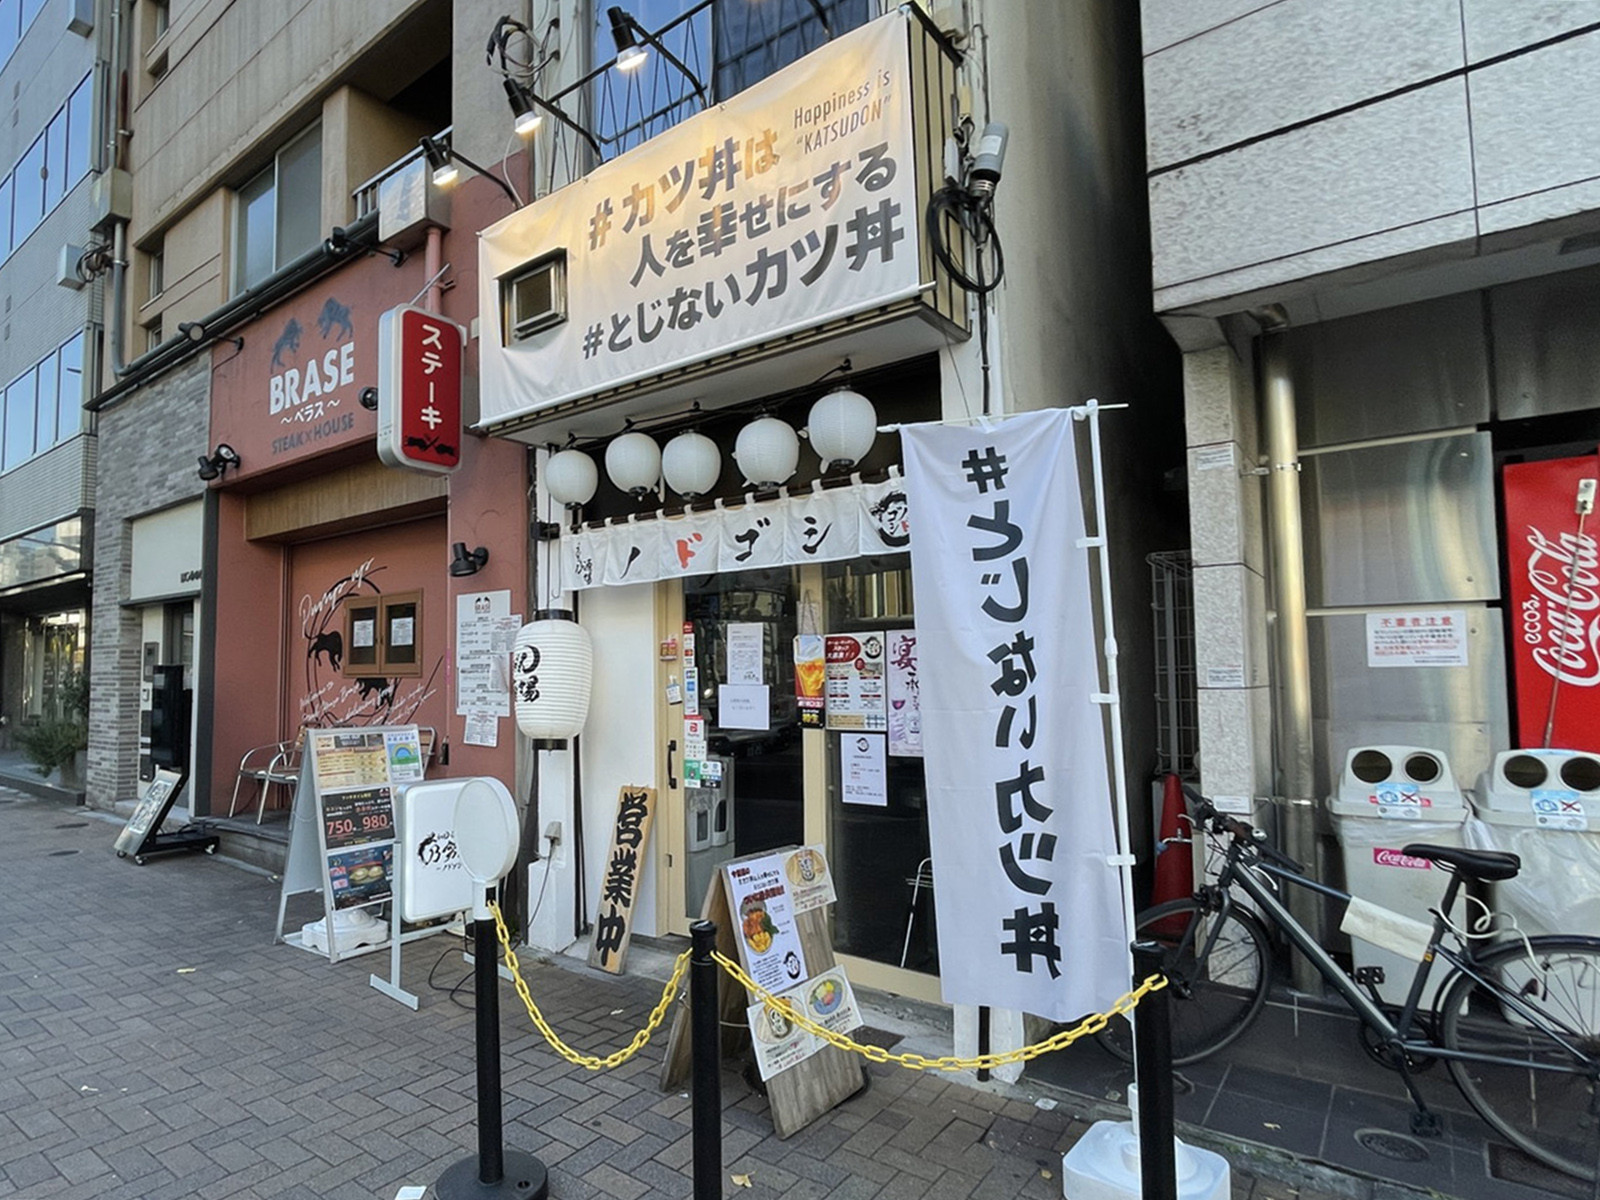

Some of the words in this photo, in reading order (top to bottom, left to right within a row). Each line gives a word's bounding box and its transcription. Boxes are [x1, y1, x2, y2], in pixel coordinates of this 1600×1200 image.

[794, 80, 870, 129] Happiness
[877, 69, 890, 88] is
[629, 142, 898, 287] 人を幸せにする
[582, 198, 905, 360] #とじないカツ丼
[270, 341, 355, 416] BRASE
[421, 323, 443, 430] ステーキ
[327, 819, 353, 835] 750
[362, 814, 387, 829] 980
[596, 792, 648, 966] 営業中
